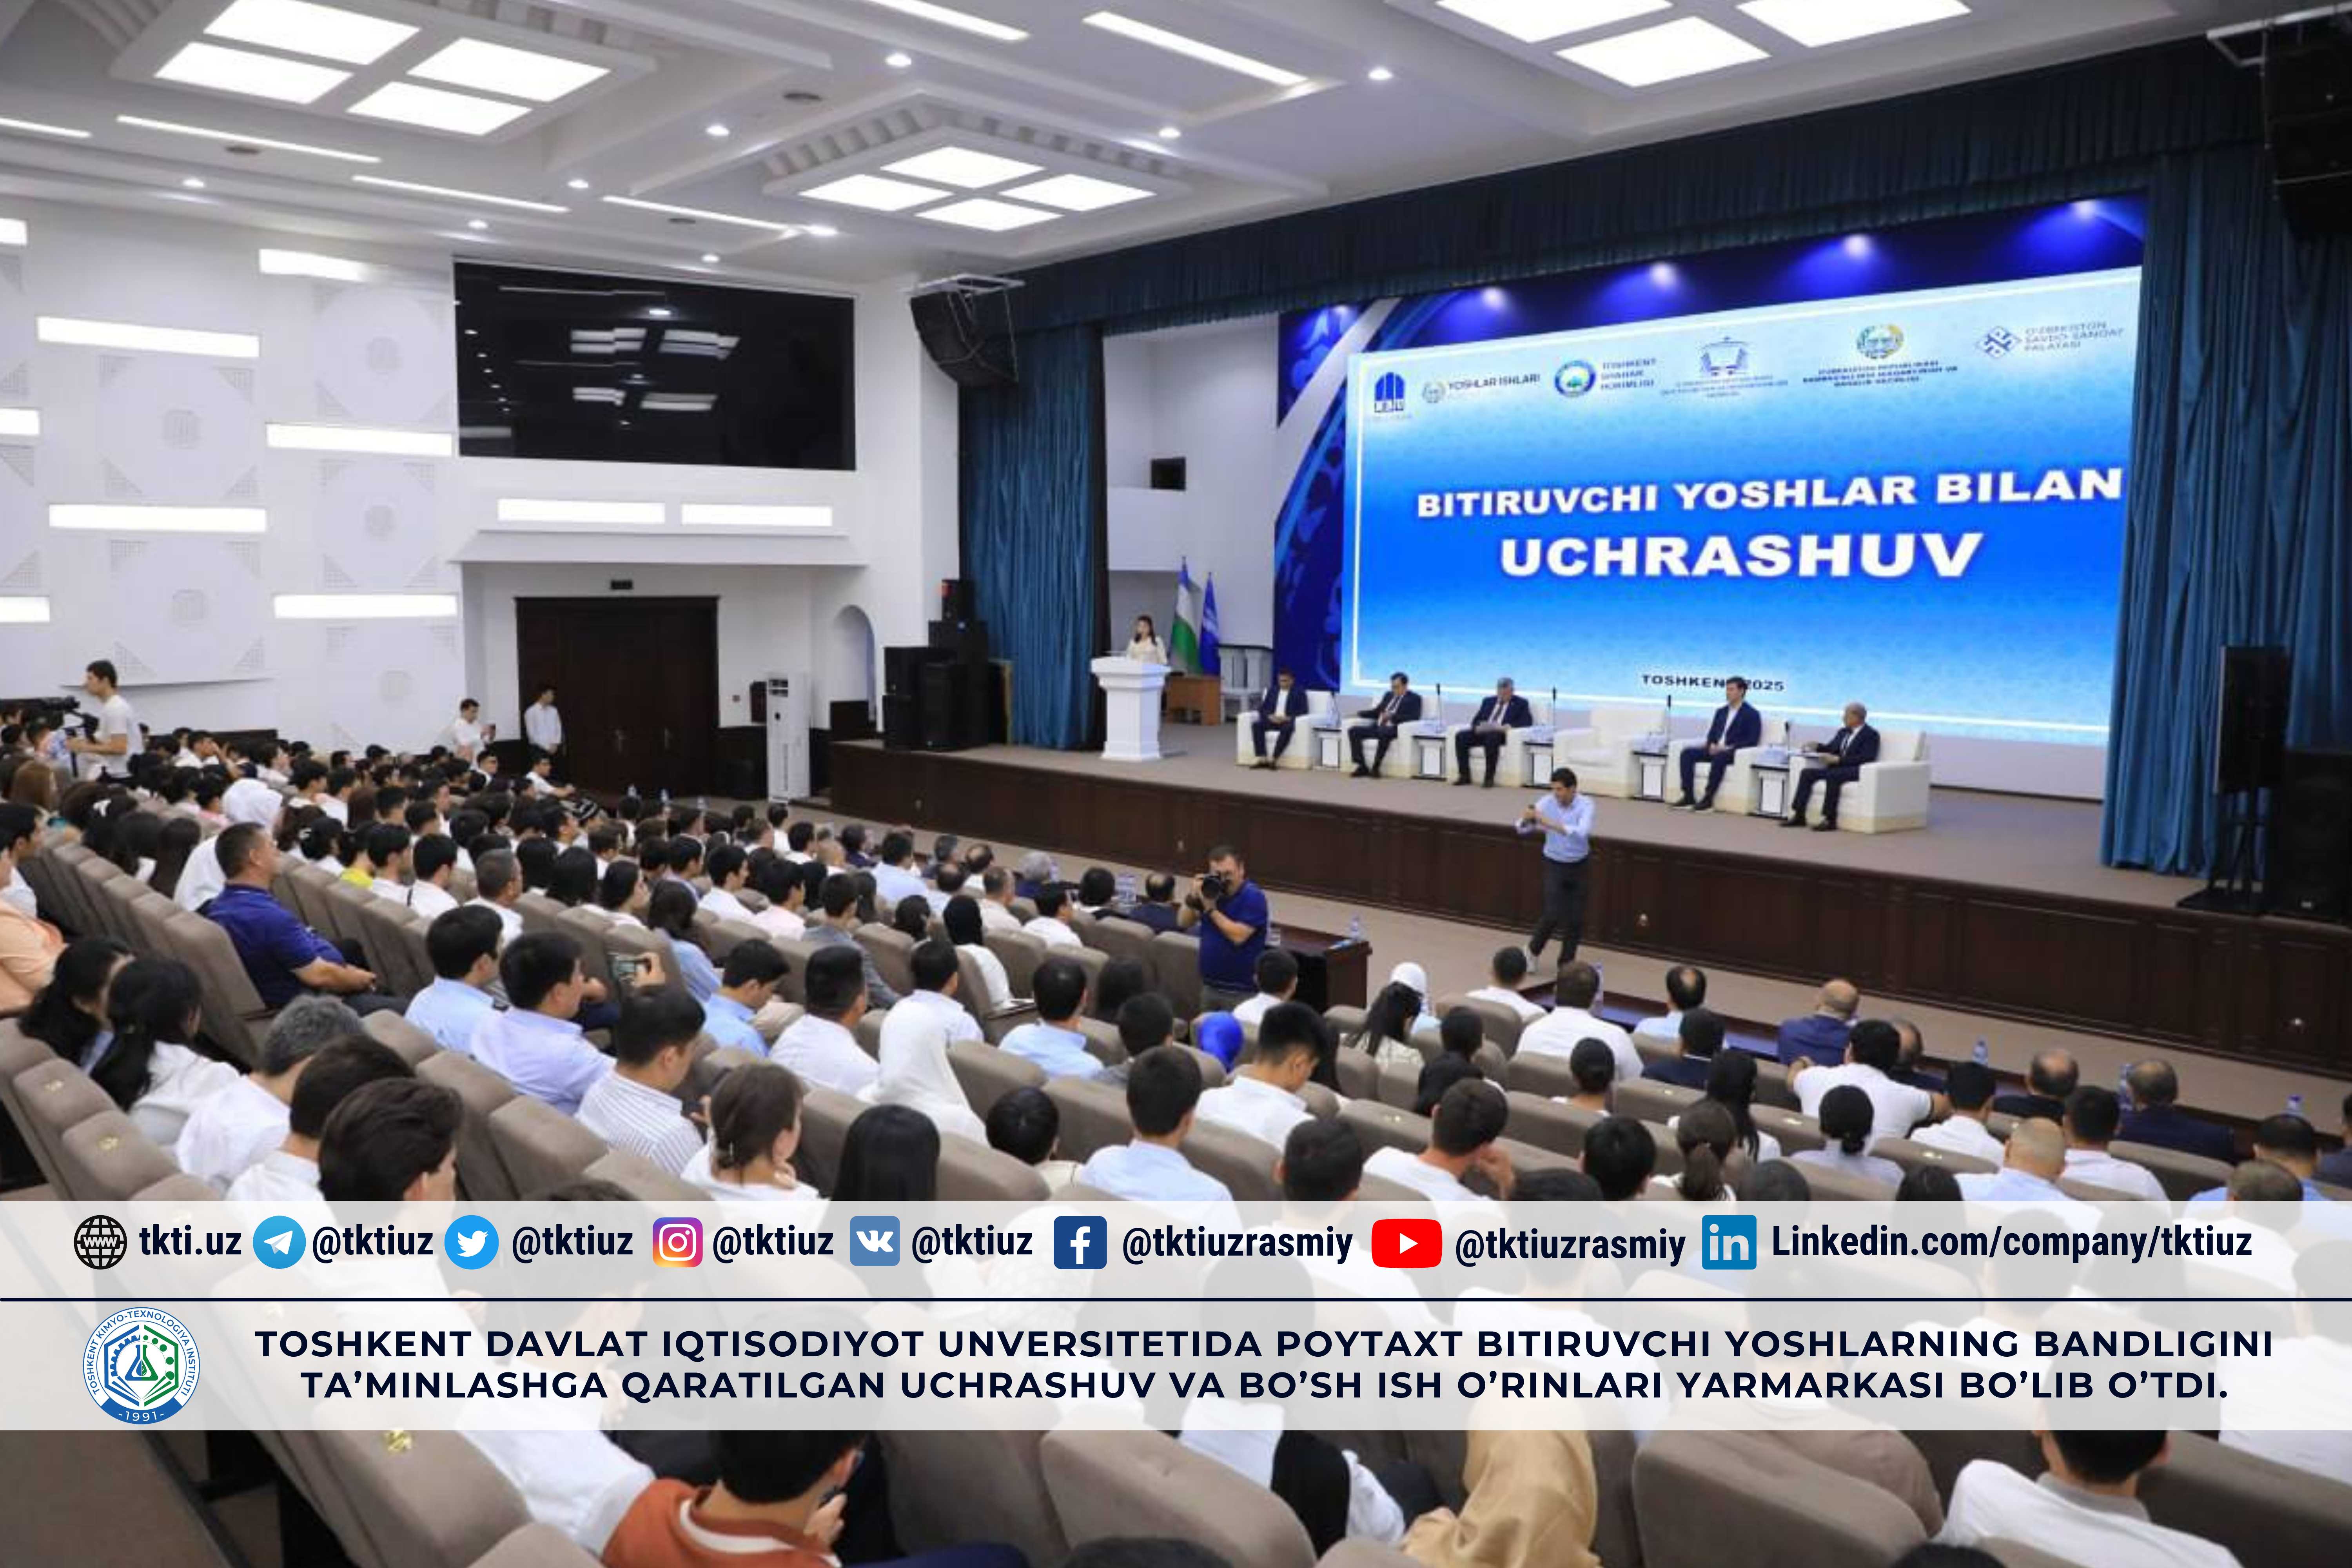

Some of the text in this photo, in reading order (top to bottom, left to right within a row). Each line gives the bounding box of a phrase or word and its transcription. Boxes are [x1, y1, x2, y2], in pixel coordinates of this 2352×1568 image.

[1448, 374, 1541, 391] YOSHLAR ISHLARI
[1417, 468, 2122, 517] BITIRUVCHI YOSHLAR BILAN
[1501, 533, 1984, 577] UCHRASHUV
[1642, 674, 1726, 689] TOSHKEN
